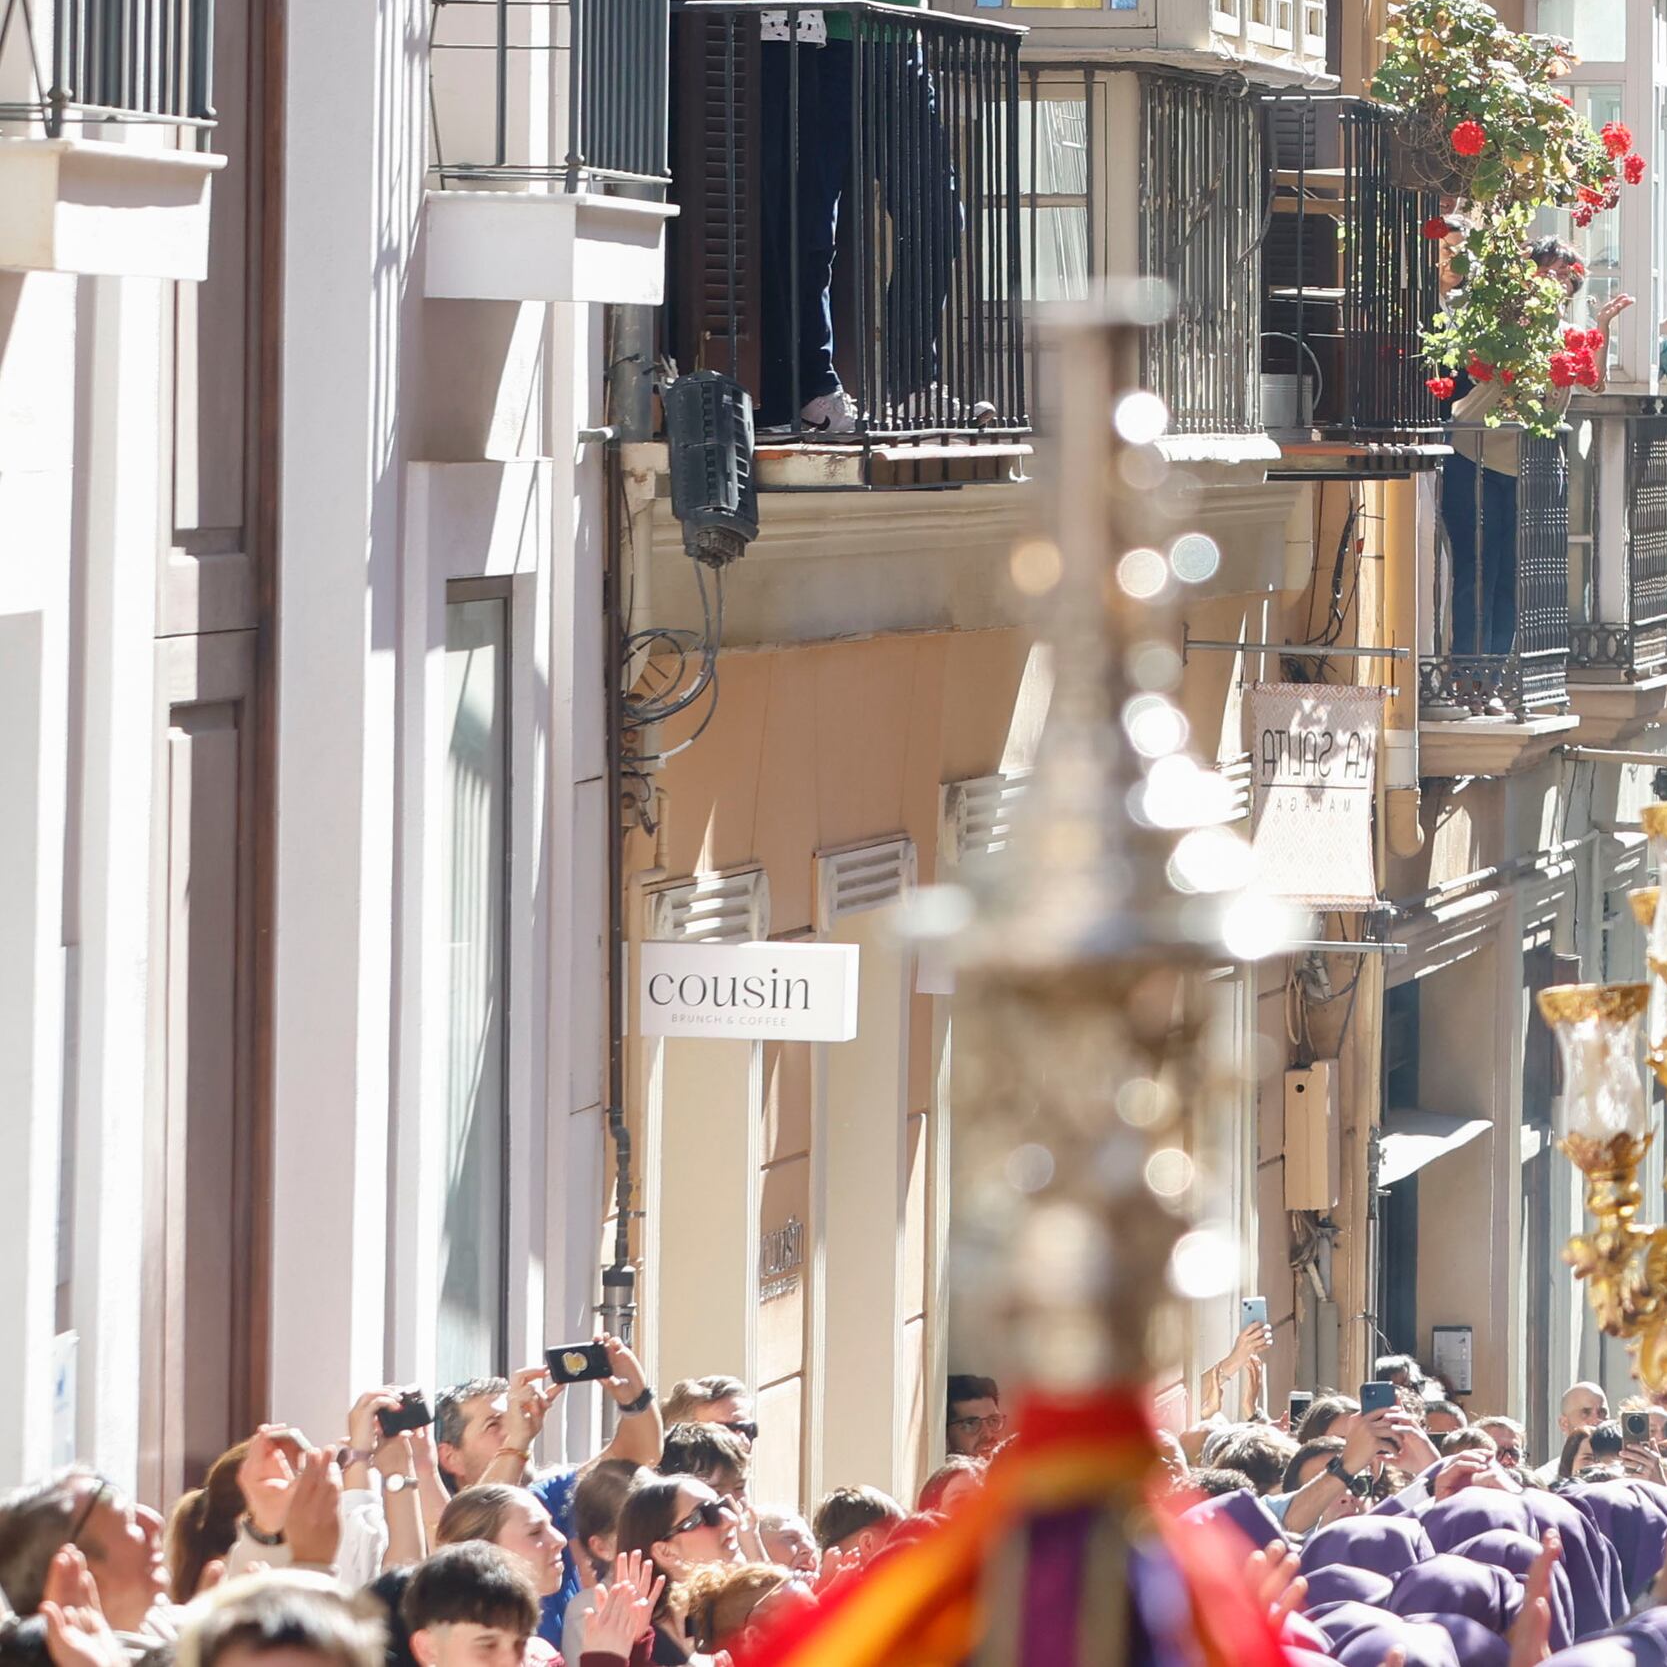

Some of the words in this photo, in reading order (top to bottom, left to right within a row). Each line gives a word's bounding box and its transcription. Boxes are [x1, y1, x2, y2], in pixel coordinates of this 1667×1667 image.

[649, 968, 811, 1010] cousin
[671, 1013, 722, 1023] BRUNCH
[728, 1016, 734, 1025] &
[739, 1016, 787, 1027] COFFEE
